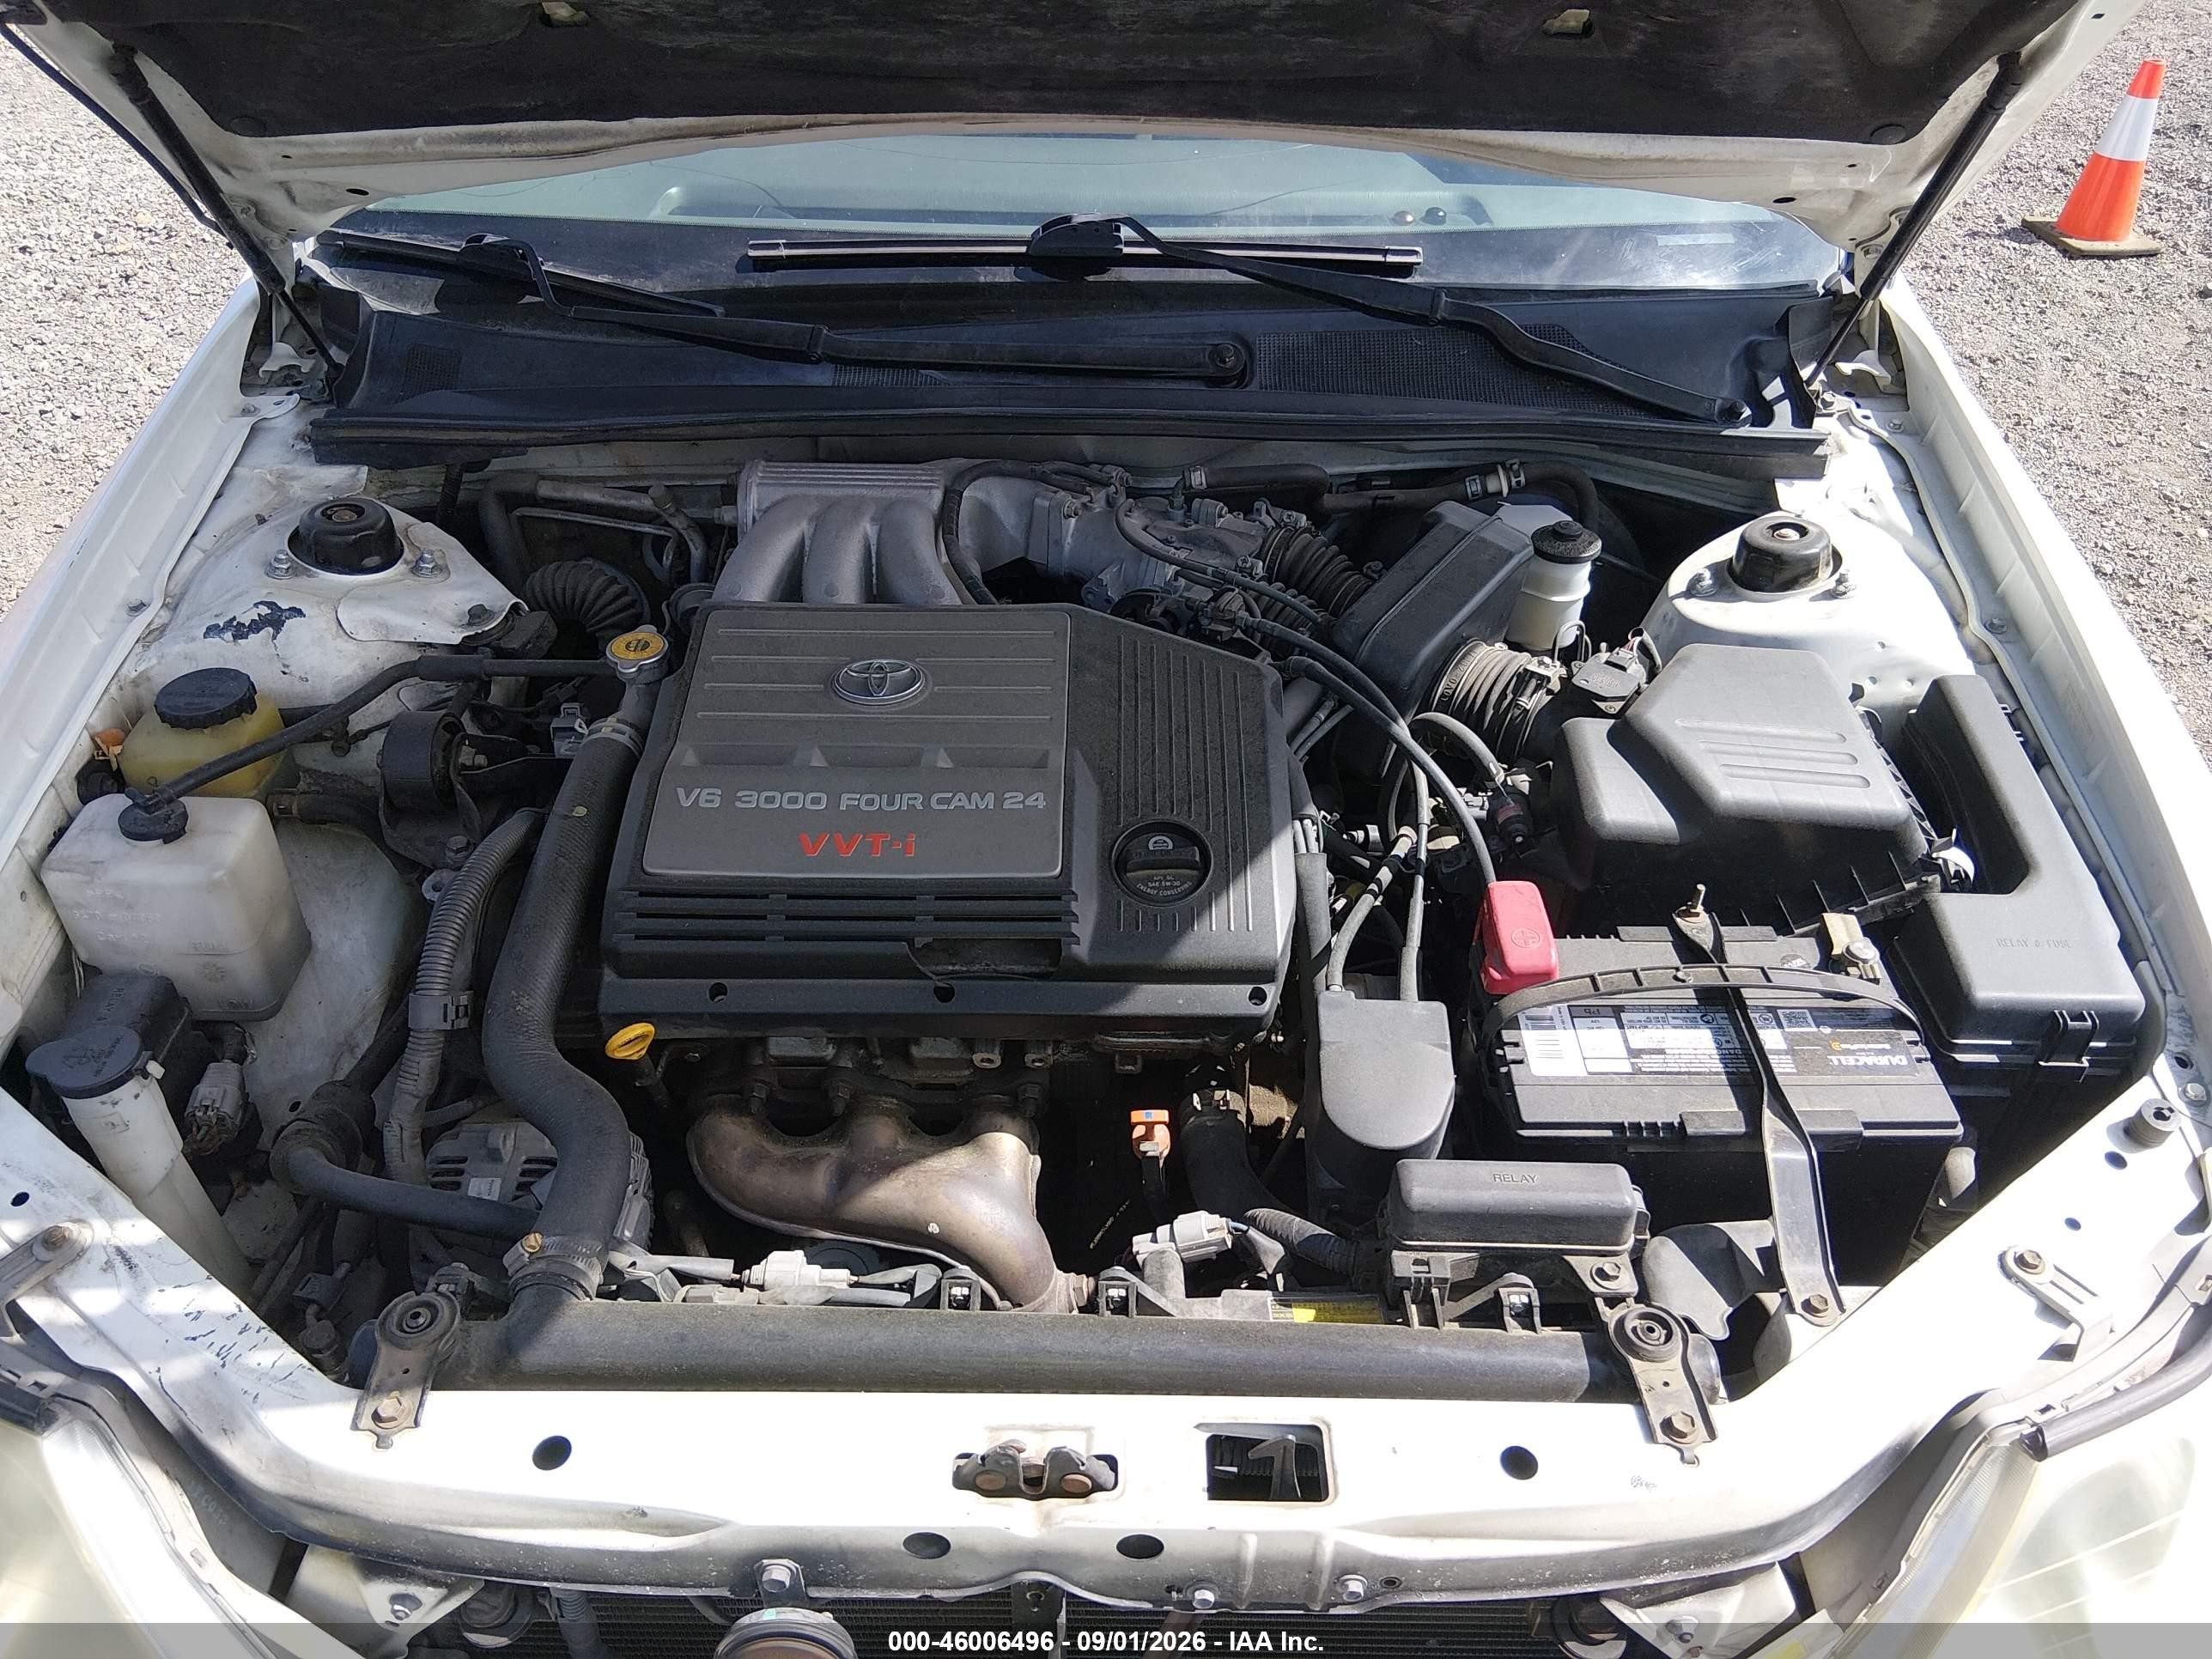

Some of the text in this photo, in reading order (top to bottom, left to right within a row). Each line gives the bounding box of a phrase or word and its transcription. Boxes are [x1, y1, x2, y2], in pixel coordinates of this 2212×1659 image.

[676, 787, 1047, 811] V6 3000 FOUR CAM 24
[798, 831, 916, 857] VVT-i
[1996, 938, 2029, 948] RELAY
[1826, 1055, 1908, 1066] DURACELL
[1492, 1173, 1537, 1183] RELAY
